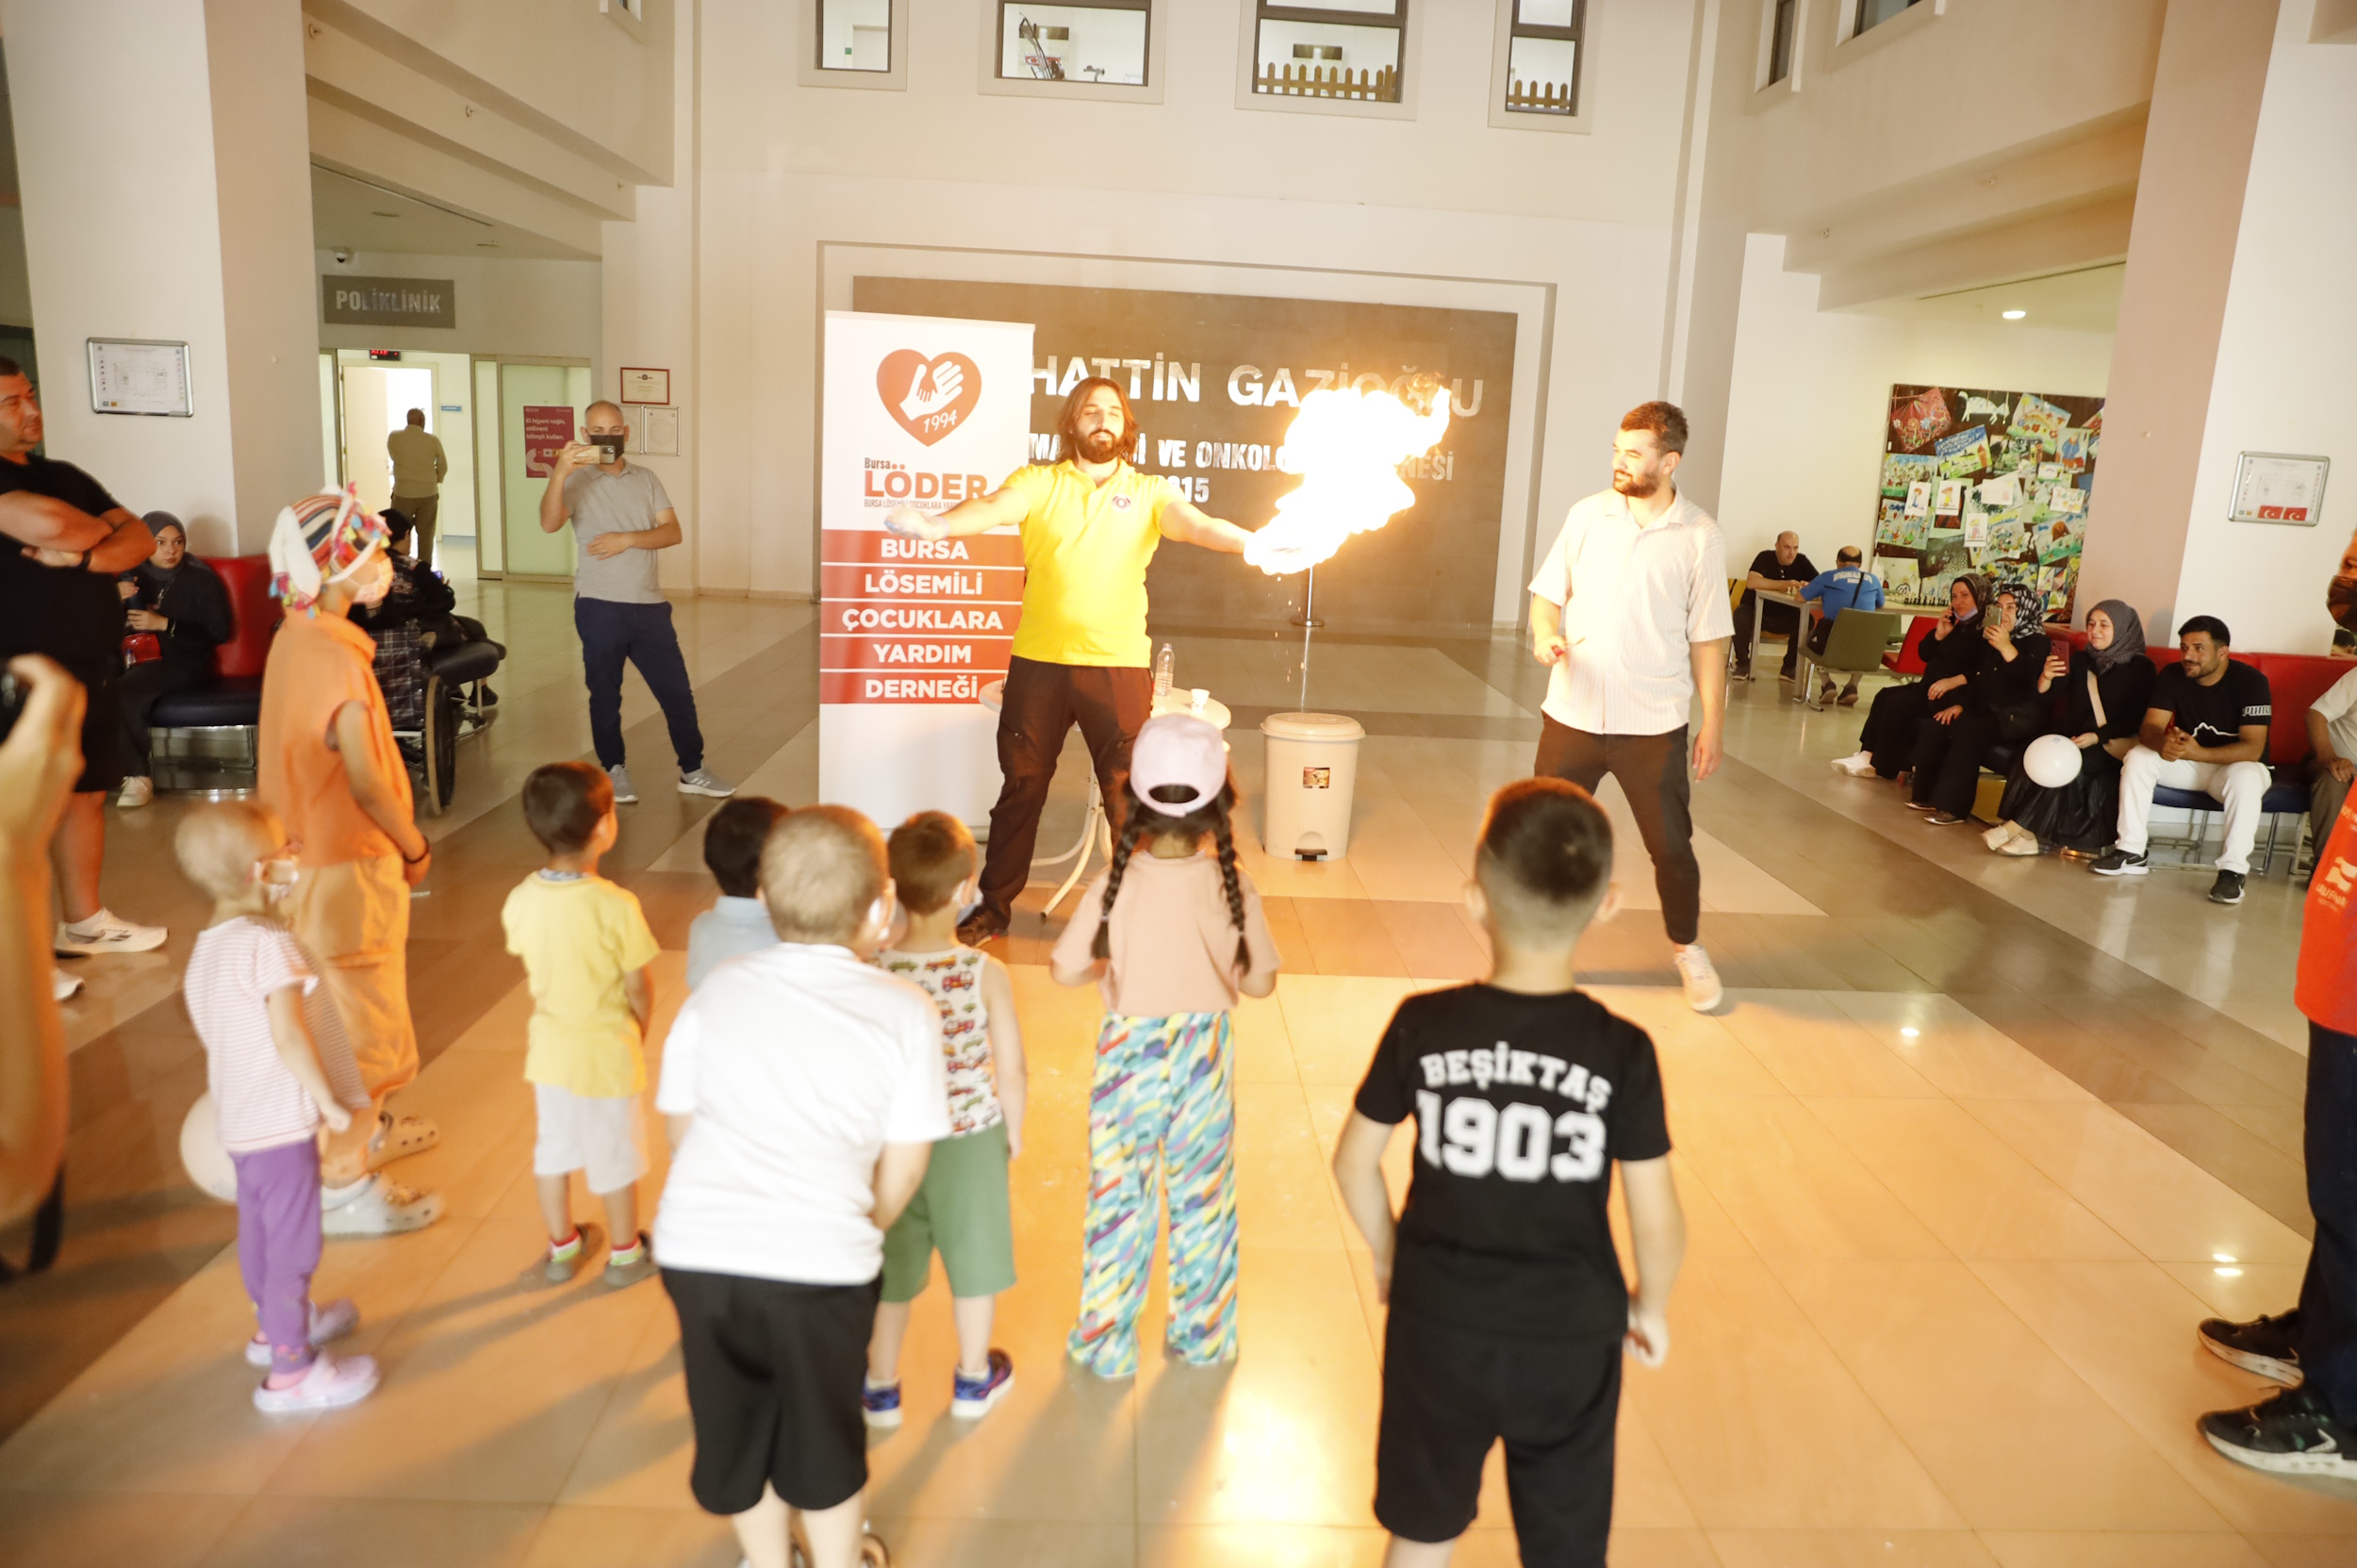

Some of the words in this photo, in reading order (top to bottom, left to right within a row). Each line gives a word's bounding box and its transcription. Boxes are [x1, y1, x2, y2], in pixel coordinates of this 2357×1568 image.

[336, 288, 441, 313] POLİKLİNİK
[923, 409, 958, 434] 1994
[865, 457, 891, 470] Bursa
[1158, 439, 1187, 468] VE
[1195, 440, 1290, 471] ONKOLO
[865, 463, 988, 501] LÖDER
[864, 499, 882, 508] BURSA
[881, 538, 969, 560] BURSA
[865, 569, 982, 595] LÖSEMİLİ
[842, 608, 1004, 632] ÇOCUKLARA
[873, 644, 972, 664] YARDIM
[865, 675, 978, 699] DERNEĞİ
[1419, 1040, 1613, 1114] BEŞİKTAŞ
[1416, 1088, 1607, 1183] 1903
